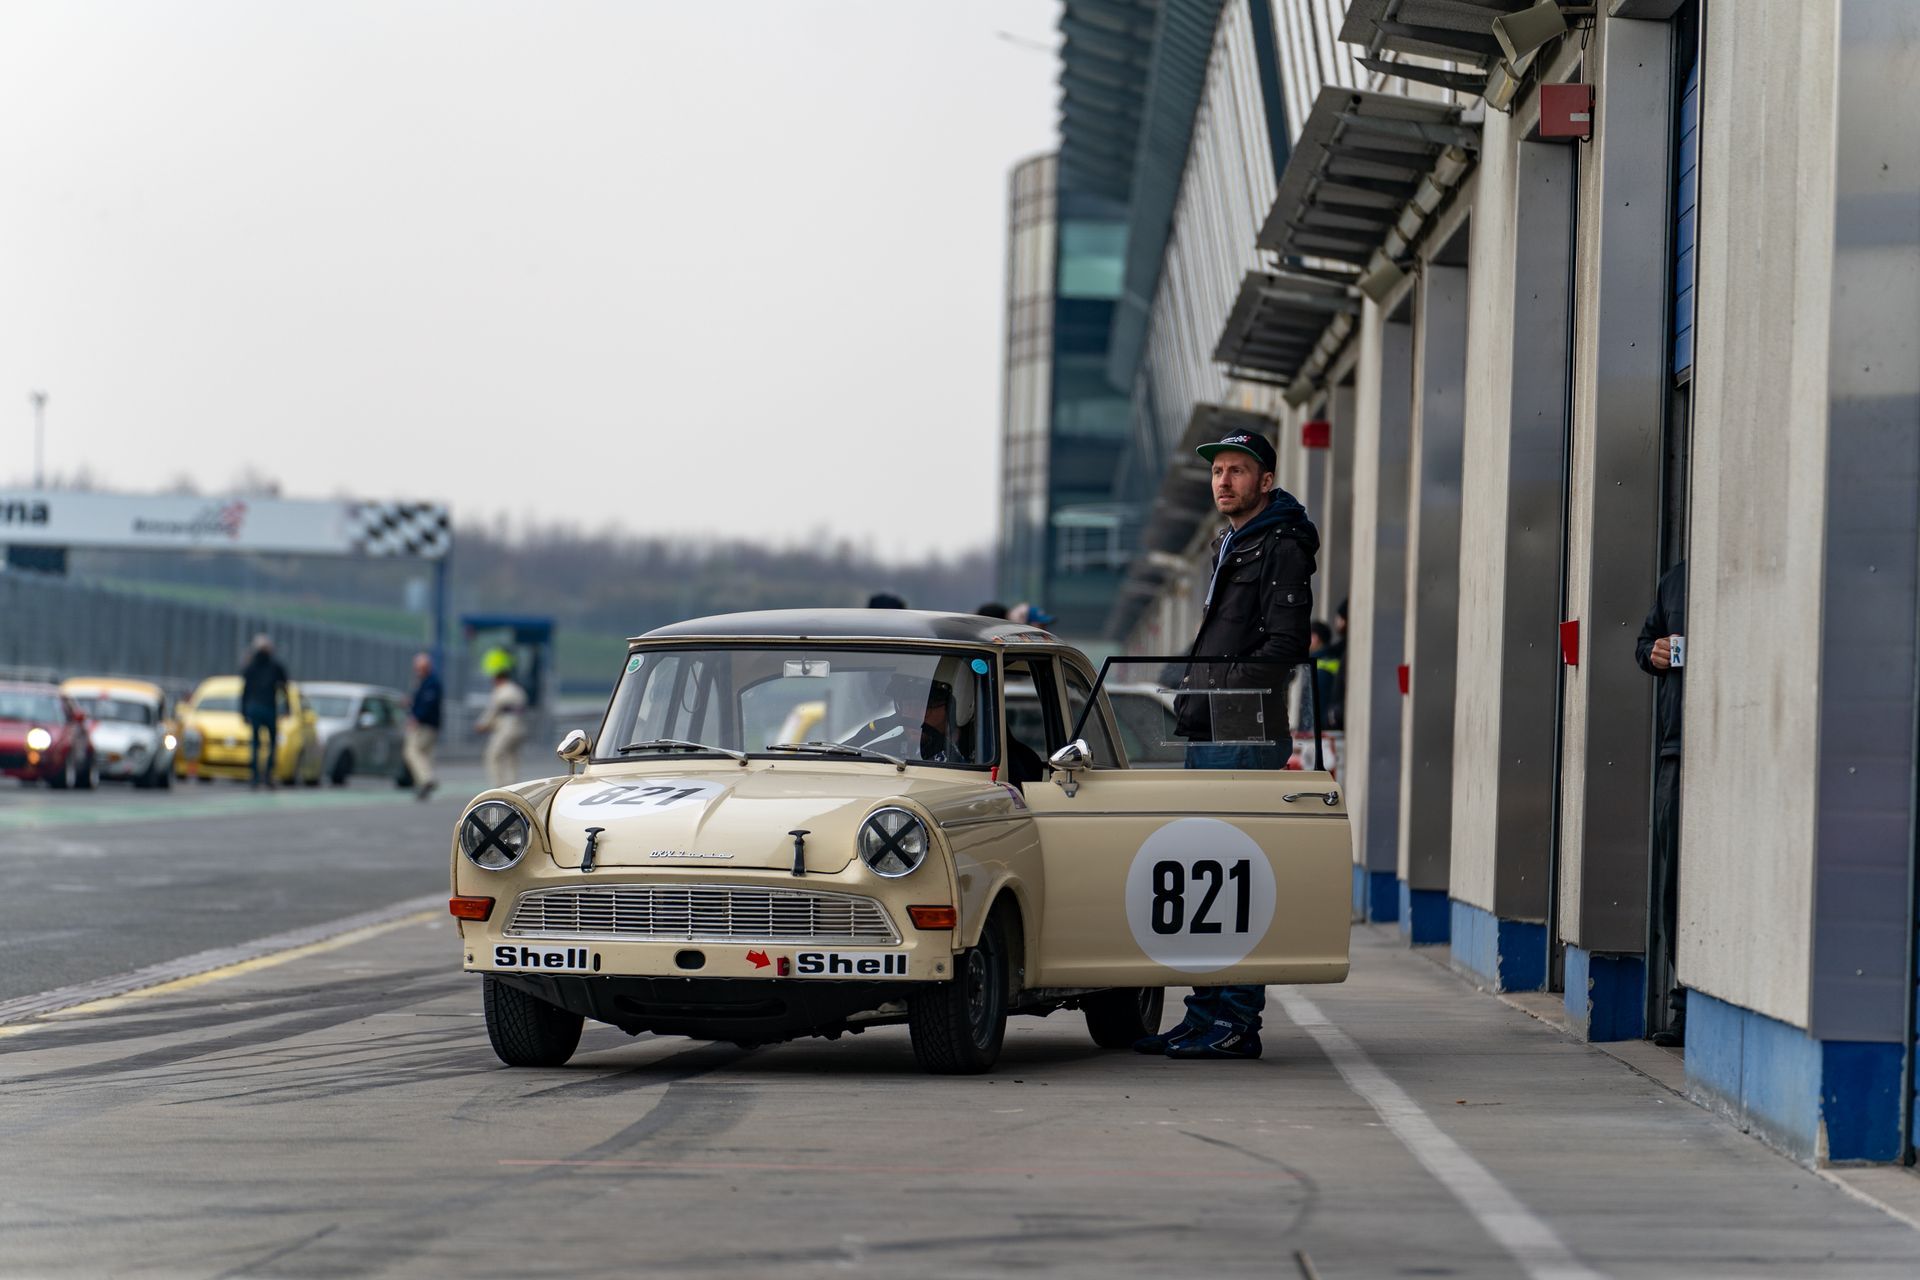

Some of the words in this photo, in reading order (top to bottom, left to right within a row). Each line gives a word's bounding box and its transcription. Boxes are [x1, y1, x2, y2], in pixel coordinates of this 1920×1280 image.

[0, 499, 50, 526] na
[578, 786, 706, 806] 821
[1151, 859, 1251, 934] 821
[495, 946, 587, 969] Shell
[797, 953, 907, 974] Shell
